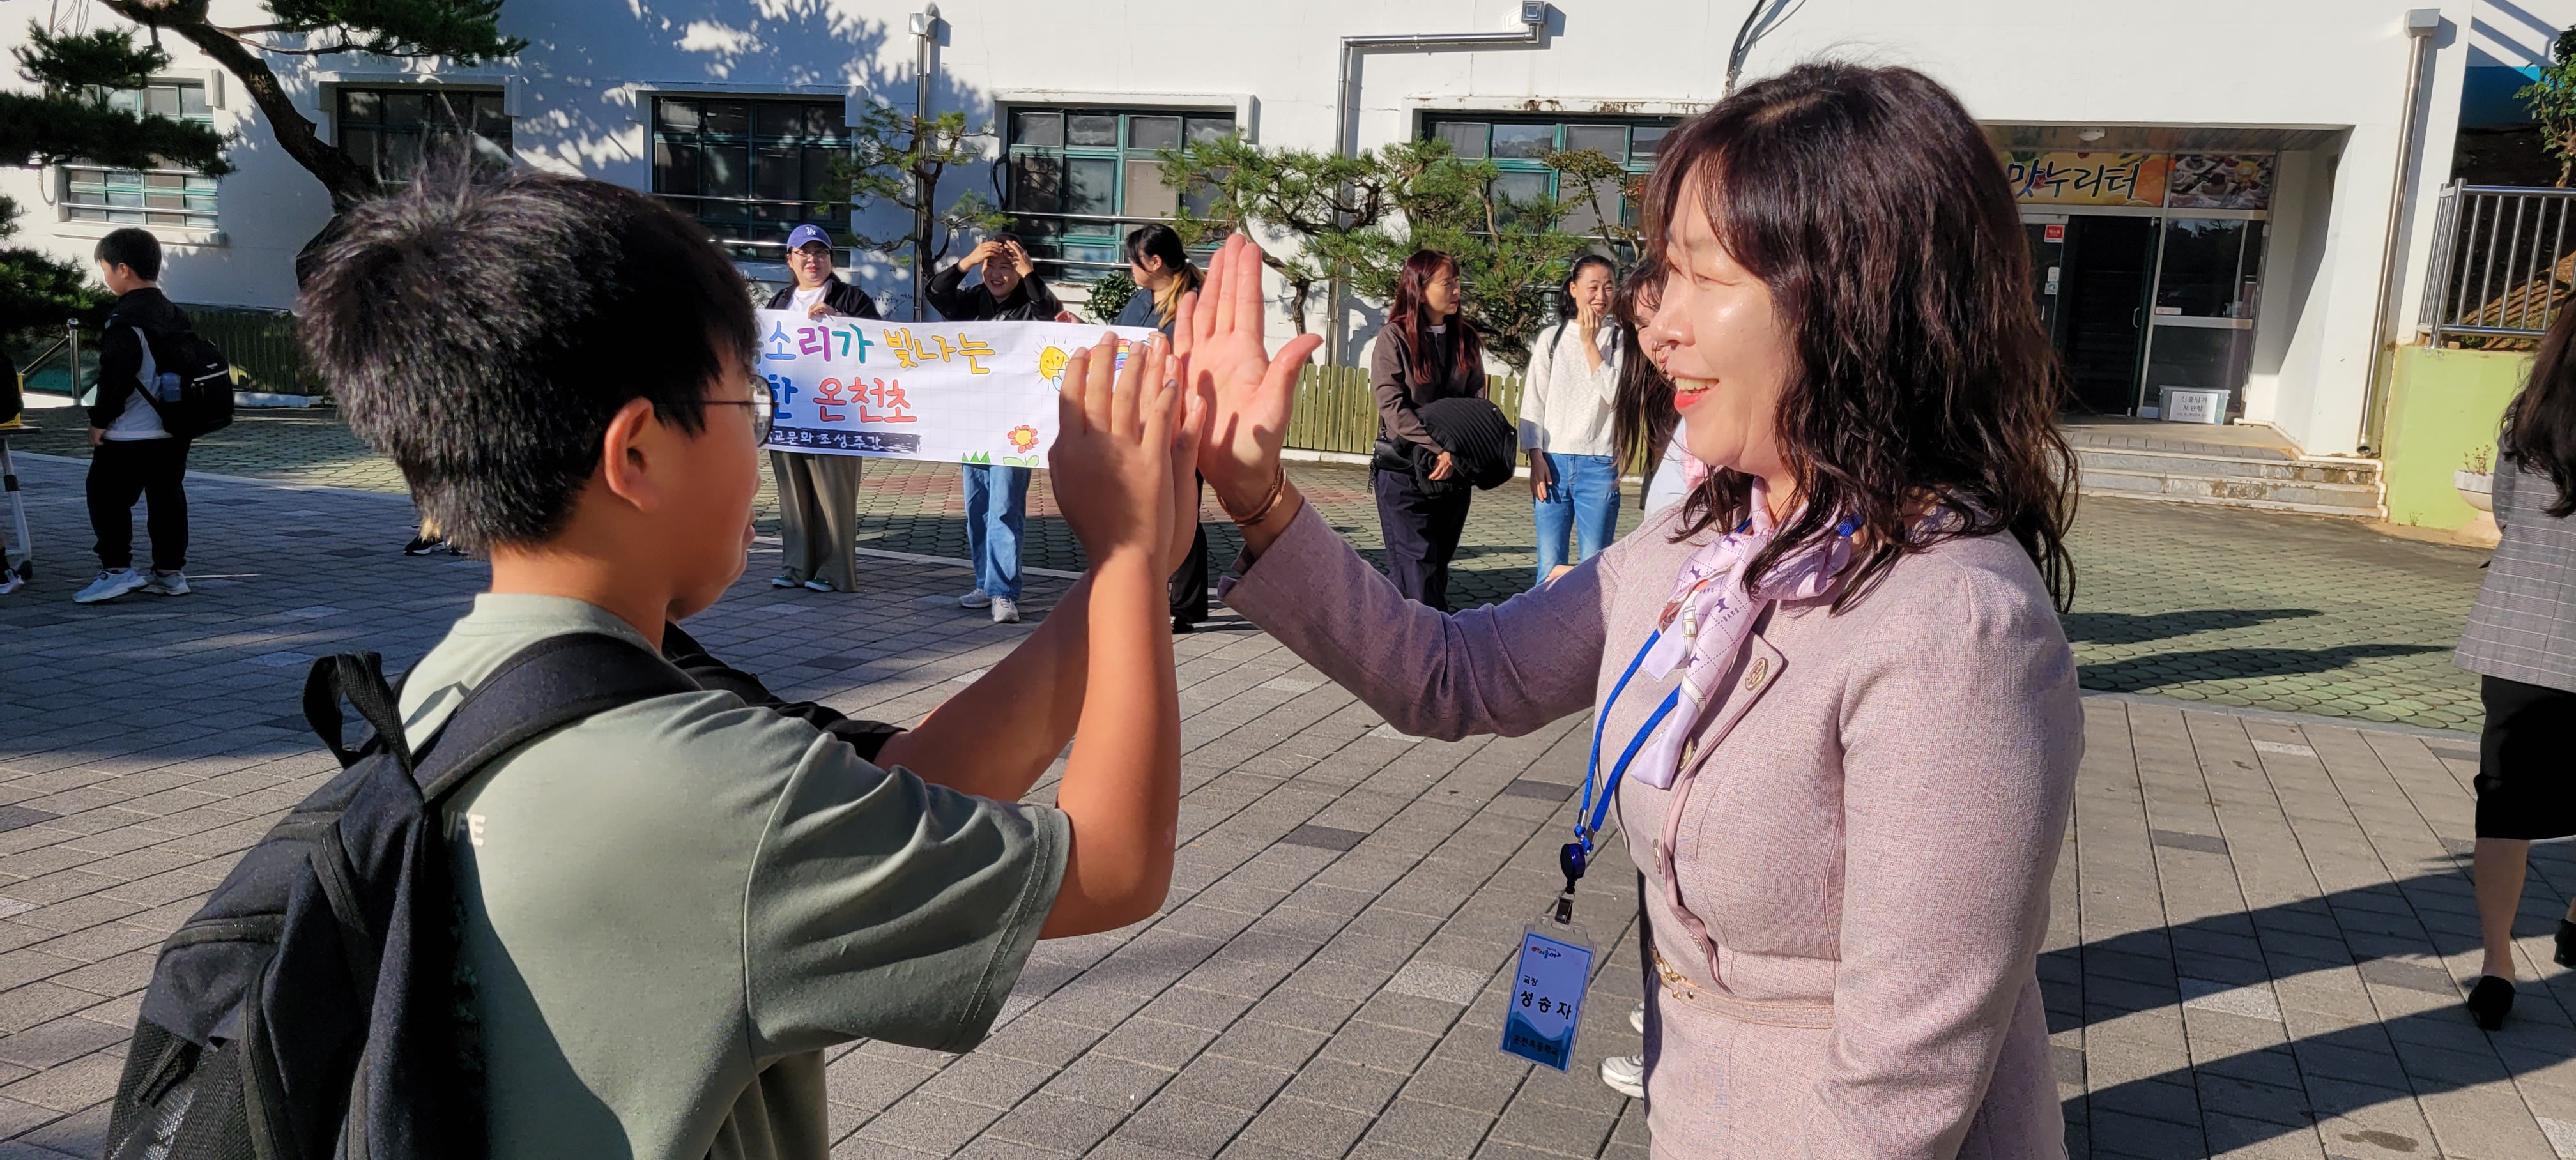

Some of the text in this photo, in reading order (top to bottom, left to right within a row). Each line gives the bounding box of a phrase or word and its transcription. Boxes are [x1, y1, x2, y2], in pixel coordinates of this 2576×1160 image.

[2007, 158, 2140, 200] 맛누리터
[806, 226, 817, 236] LA
[754, 321, 996, 374] 소리가 빛나는
[813, 376, 918, 423] 온천초
[818, 434, 848, 448] 조성
[852, 436, 882, 450] 주간
[1523, 975, 1538, 987] 교장
